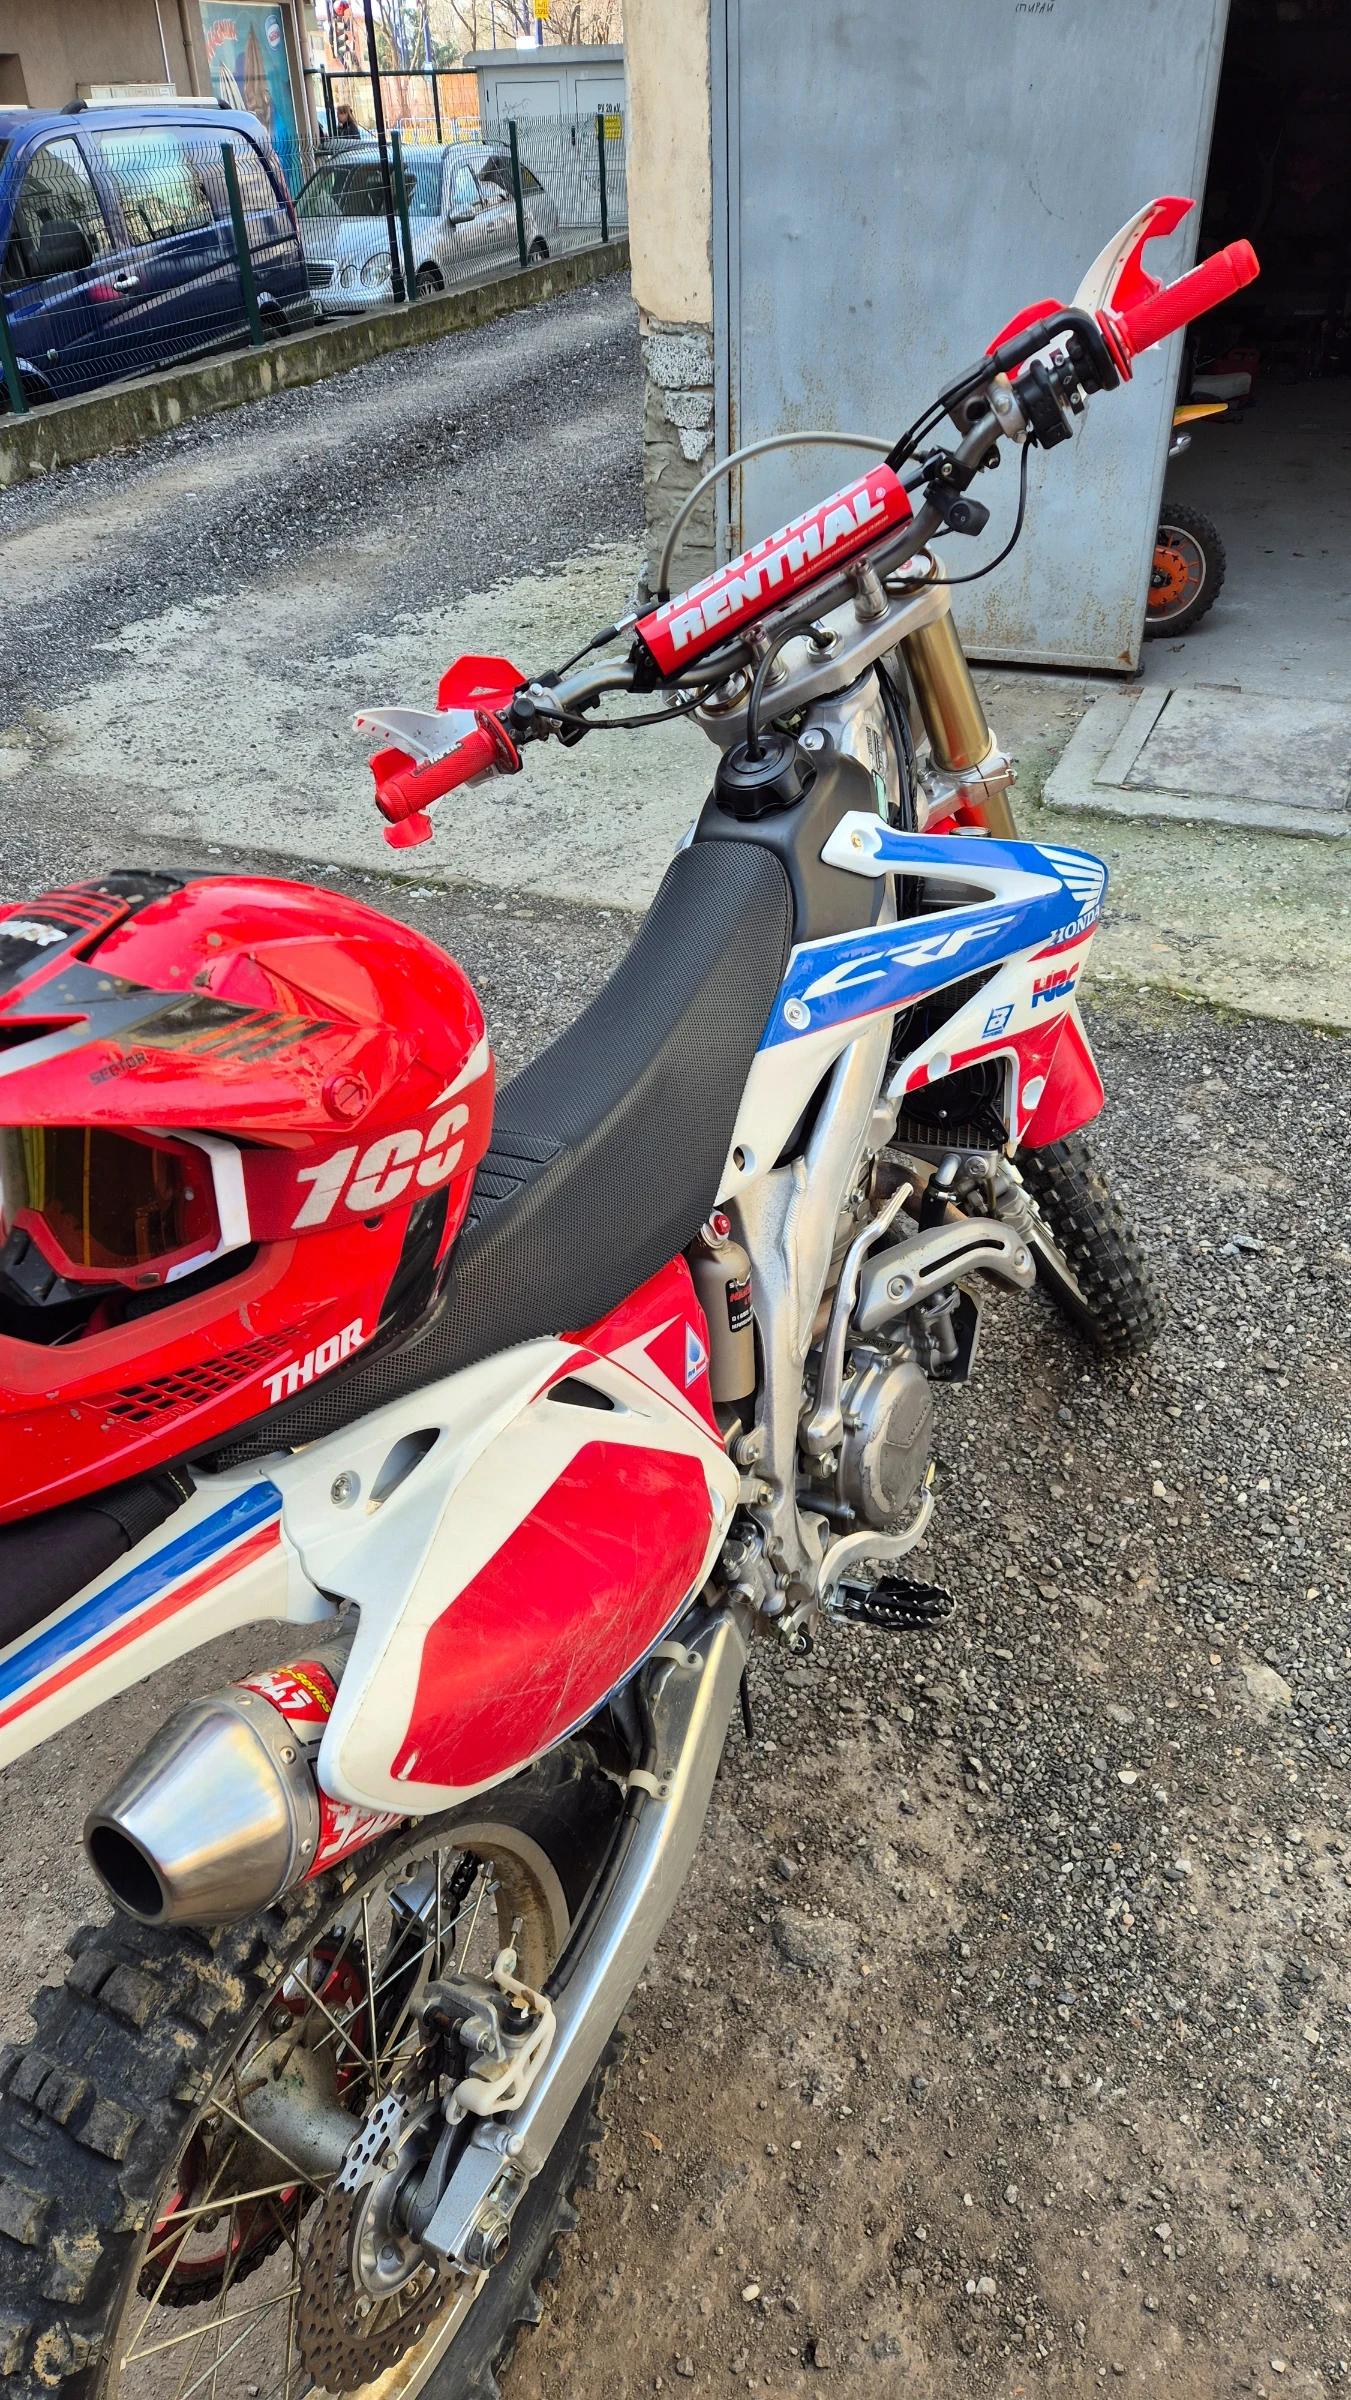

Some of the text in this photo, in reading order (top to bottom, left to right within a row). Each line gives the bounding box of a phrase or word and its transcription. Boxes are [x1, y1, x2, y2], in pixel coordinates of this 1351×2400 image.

[669, 488, 885, 651] RENTHAL
[801, 914, 1017, 1002] CRF
[1047, 904, 1101, 946] HONDA
[1031, 961, 1080, 1009] HRC
[89, 1050, 149, 1086] SECTOR
[262, 1316, 367, 1405] THOR
